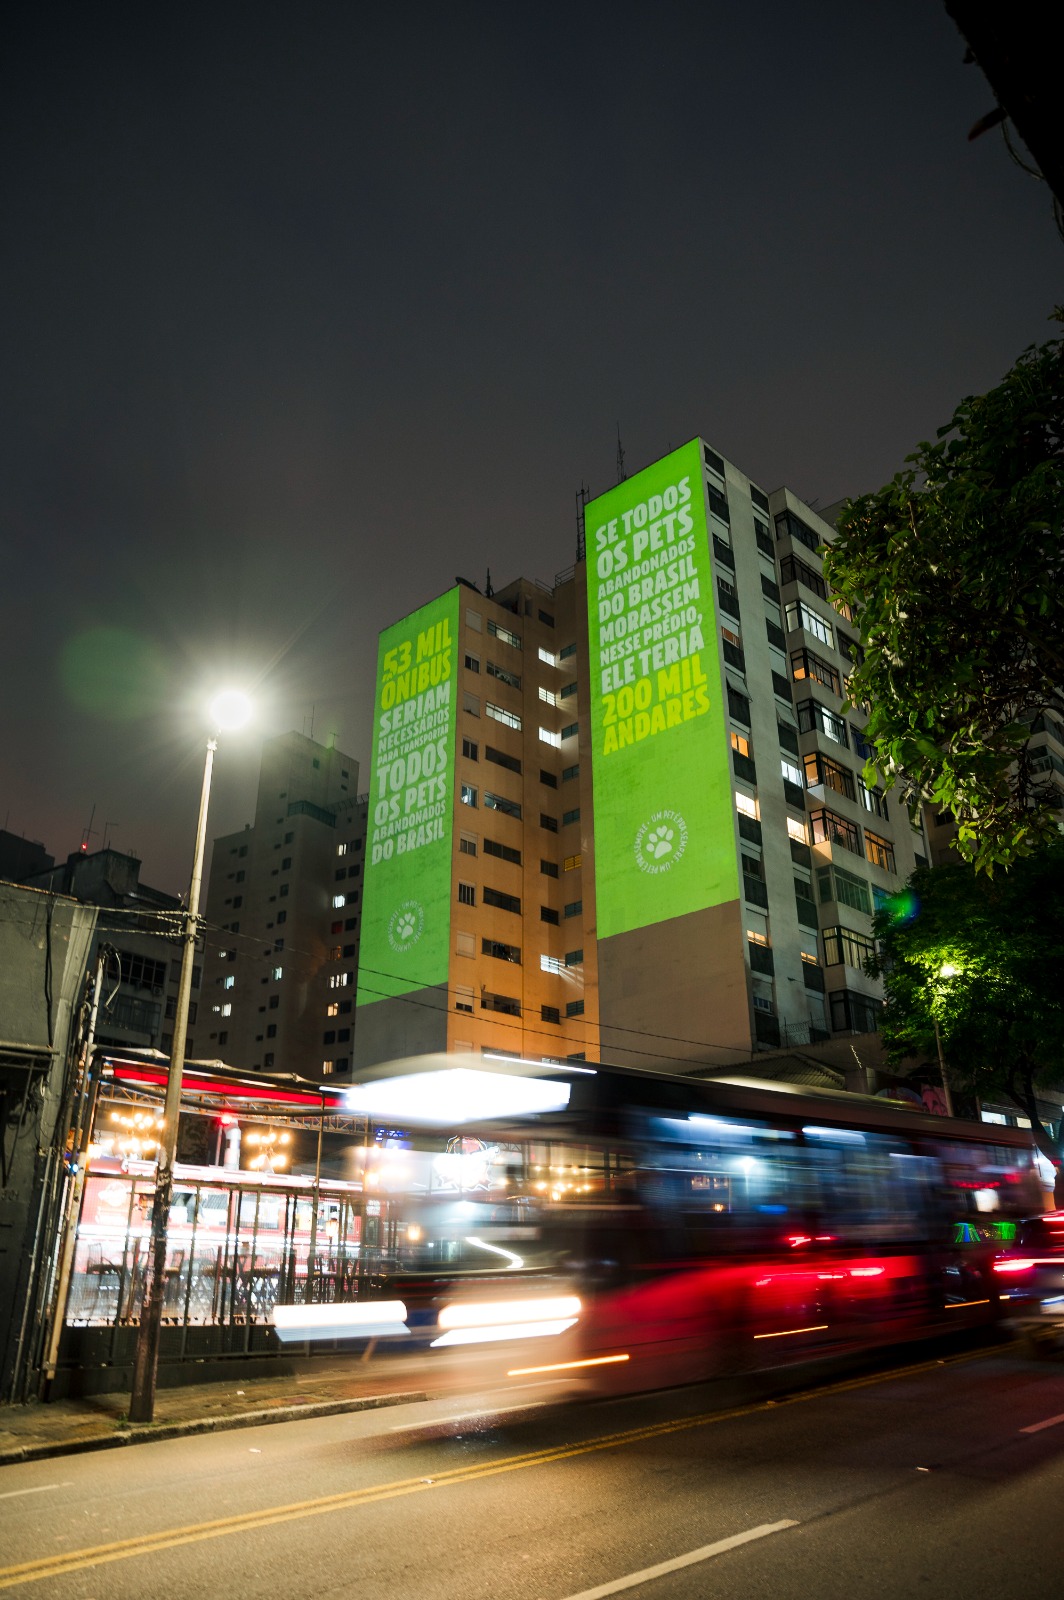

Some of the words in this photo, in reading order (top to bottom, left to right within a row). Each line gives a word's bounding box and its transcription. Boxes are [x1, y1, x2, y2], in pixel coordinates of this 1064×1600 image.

[596, 518, 618, 551] SE
[622, 476, 691, 534] TODOS
[597, 540, 627, 579] OS
[633, 504, 693, 561] PETS
[598, 535, 696, 600] ABANDONADOS
[599, 592, 624, 623] DO
[628, 555, 697, 607] BRASIL
[600, 578, 699, 647] MORASSEM
[601, 633, 641, 667] NESSE
[644, 606, 703, 645] PRÉDIO,
[383, 641, 412, 675] 53
[416, 618, 451, 664] MIL
[602, 656, 635, 695] ELE
[639, 625, 704, 676] TERIA
[379, 681, 450, 737] SERIAM
[381, 649, 451, 710] ÔNIBUS
[602, 677, 652, 726] 200
[658, 654, 707, 701] MIL
[377, 747, 399, 767] PARA
[400, 724, 448, 755] TRANSPORTAR
[378, 706, 449, 754] NECESSÁRIOS
[602, 684, 710, 756] ANDARES
[377, 737, 447, 799] TODOS
[372, 800, 446, 844] ABANDONADOS
[375, 793, 400, 826] OS
[405, 772, 446, 814] PETS
[372, 839, 394, 866] DO
[397, 817, 445, 855] BRASIL
